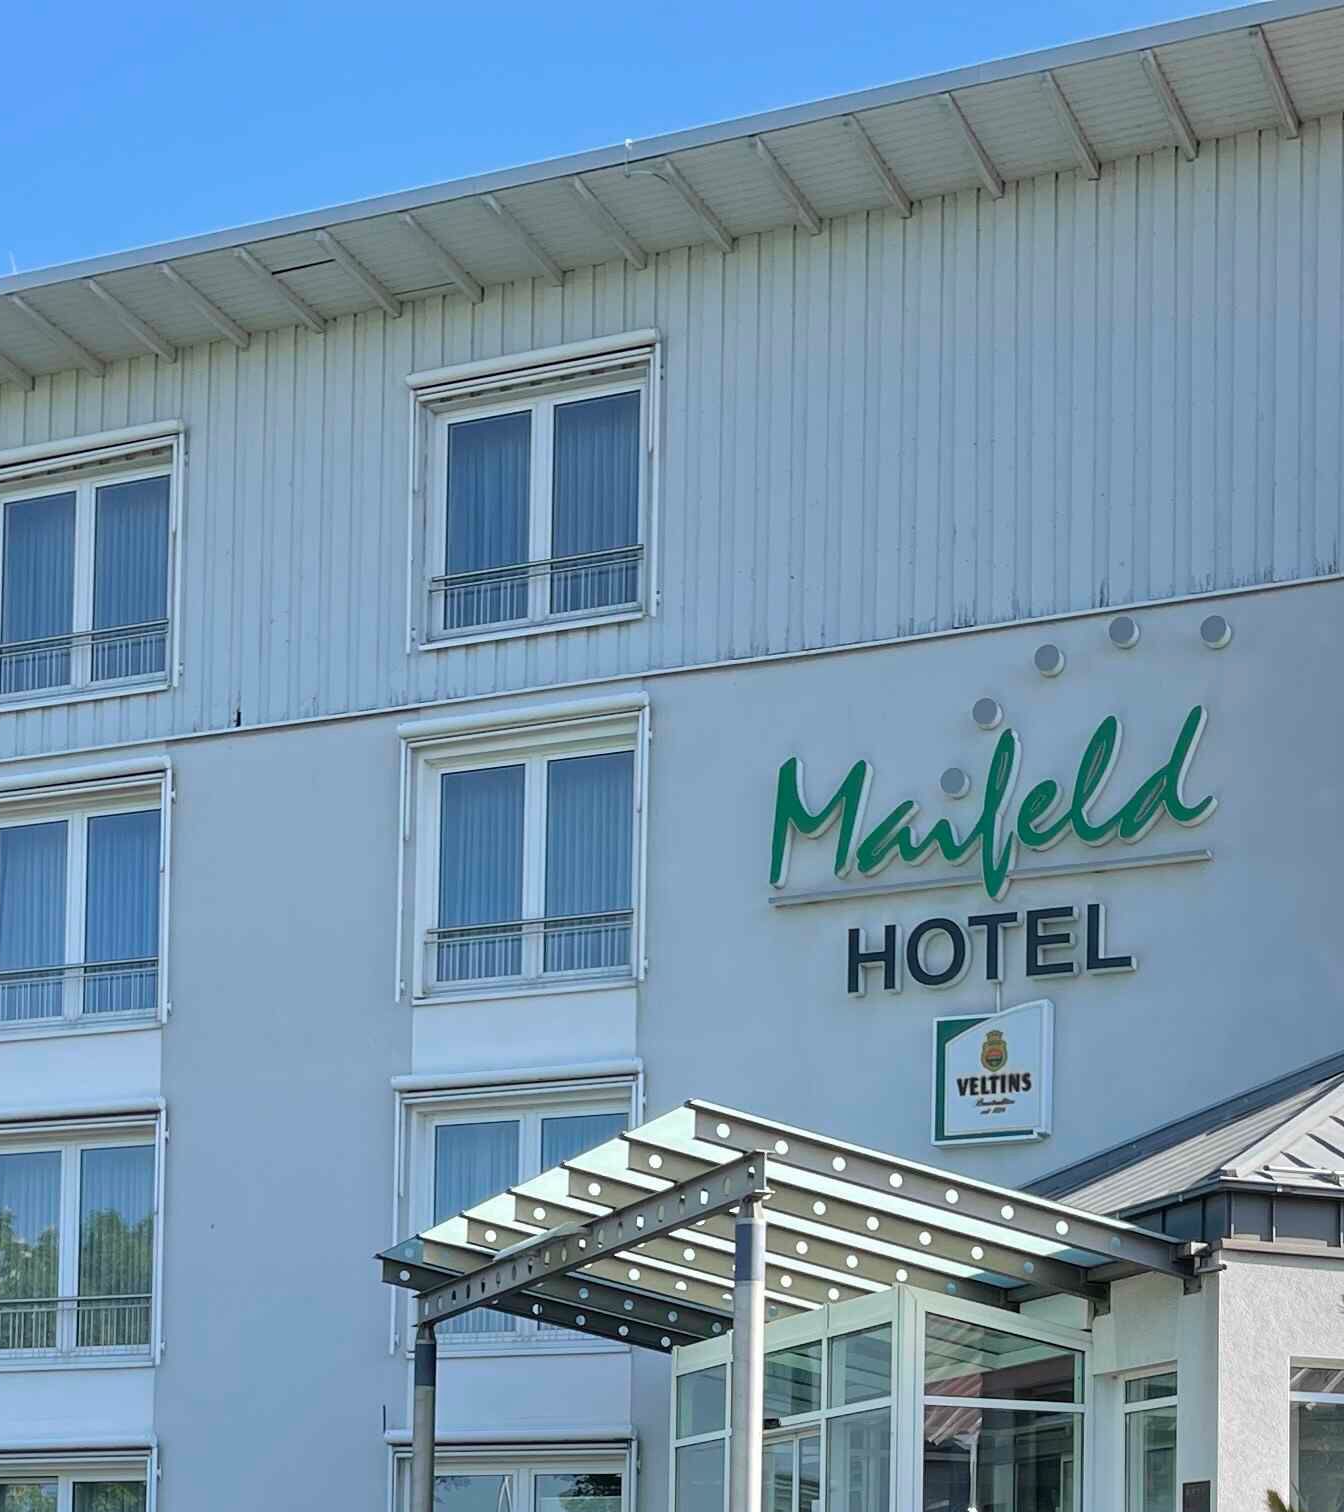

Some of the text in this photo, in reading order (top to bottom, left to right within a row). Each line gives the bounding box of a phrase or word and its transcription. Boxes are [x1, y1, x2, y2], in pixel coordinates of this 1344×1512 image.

[770, 704, 1217, 900] Maifeld
[847, 903, 1137, 995] HOTEL
[956, 1072, 1032, 1096] VELTINS
